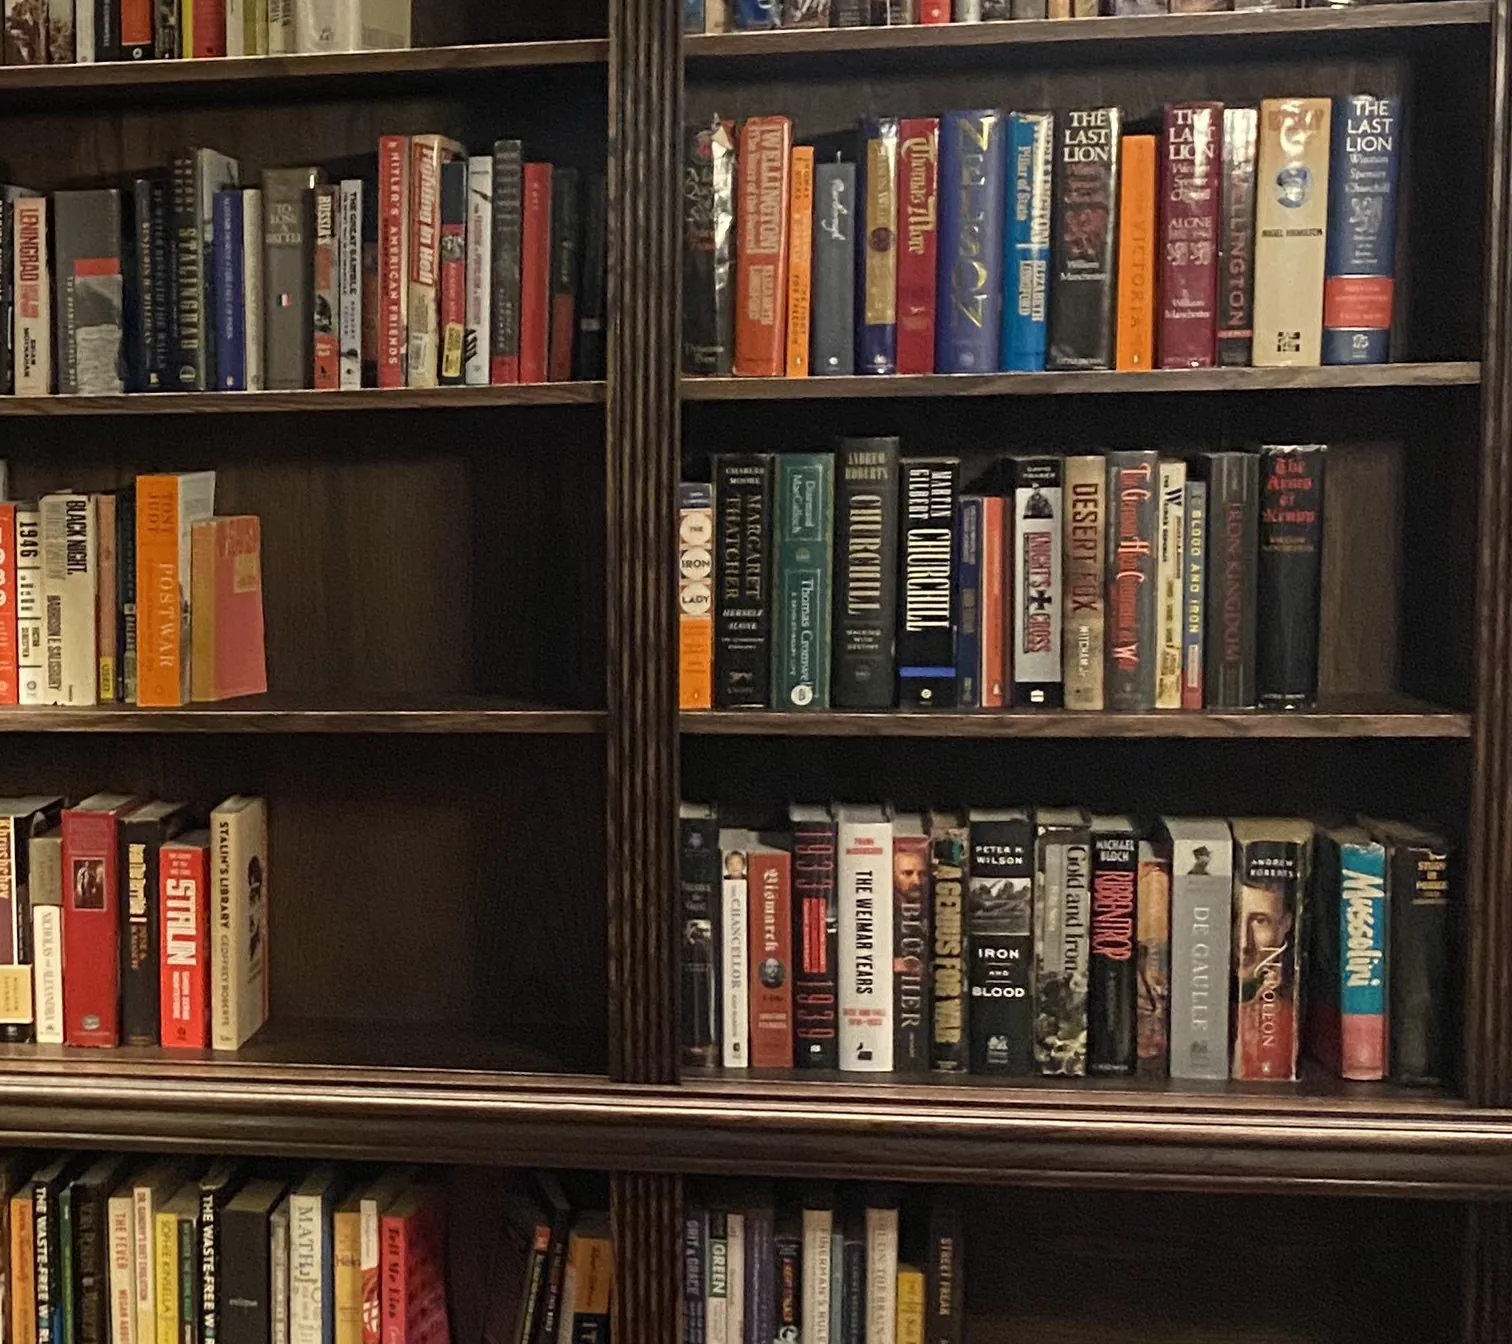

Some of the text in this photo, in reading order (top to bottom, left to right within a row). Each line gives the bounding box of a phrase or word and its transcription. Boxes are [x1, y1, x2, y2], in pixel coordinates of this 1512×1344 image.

[1064, 129, 1109, 145] LAST
[1069, 111, 1108, 127] THE
[1346, 136, 1392, 152] LION
[1347, 117, 1393, 134] LAST
[1353, 100, 1390, 116] THE
[1063, 146, 1109, 162] LION
[350, 191, 358, 212] THE
[350, 213, 358, 247] GREAT
[20, 208, 39, 282] LENINGRAD
[388, 151, 400, 365] HITLER'S AMERICAN FRIENDS
[1130, 219, 1147, 328] VICTORIA
[179, 227, 199, 350] STALINGRAD
[162, 491, 175, 533] TONY
[908, 468, 930, 520] GILBERT
[930, 469, 953, 518] MARTIN
[1072, 482, 1099, 564] DESERT
[19, 520, 39, 558] 1946
[66, 500, 87, 576] BLACK NIGHT,
[682, 559, 710, 568] IRON
[725, 496, 740, 599] THATCHER
[746, 495, 762, 600] MARGARET
[848, 494, 882, 616] CHURCHILL
[1189, 510, 1202, 633] BLOOD AND IRON
[158, 561, 177, 668] POSTWAR
[682, 594, 710, 605] LADY
[801, 578, 815, 628] Thomas
[906, 527, 952, 632] CHURCHILL
[1030, 530, 1052, 653] KNIGHT'S CROSS
[1226, 504, 1243, 662] IRON KINGDOM
[219, 821, 230, 876] STALIN'S
[976, 845, 1011, 854] PETER
[976, 856, 1024, 865] WILSON
[166, 877, 197, 966] STALIN
[219, 877, 230, 928] LIBRARY
[763, 867, 779, 951] Bismarck
[794, 831, 833, 1038] 1933 1939
[855, 870, 873, 995] THE WEIMAR YEARS
[1064, 845, 1086, 971] Gold and Iron
[1092, 870, 1135, 961] RIBBENTROP
[1341, 868, 1385, 987] Mussolini
[731, 898, 742, 989] CHANCELLOR
[934, 865, 961, 1043] A GENIUS FOR WAR
[978, 948, 1020, 959] IRON
[1192, 905, 1210, 1031] DE GAULLE
[972, 986, 1025, 998] BLOOD
[1254, 942, 1289, 1047] NAPOLEON
[36, 1186, 47, 1213] THE
[202, 1195, 214, 1222] THE
[36, 1216, 49, 1301] WASTE-FREE
[116, 1212, 128, 1269] THE FEVER
[202, 1224, 215, 1311] WASTE-FREE
[712, 1242, 726, 1294] GREEN
[940, 1237, 952, 1278] STREET
